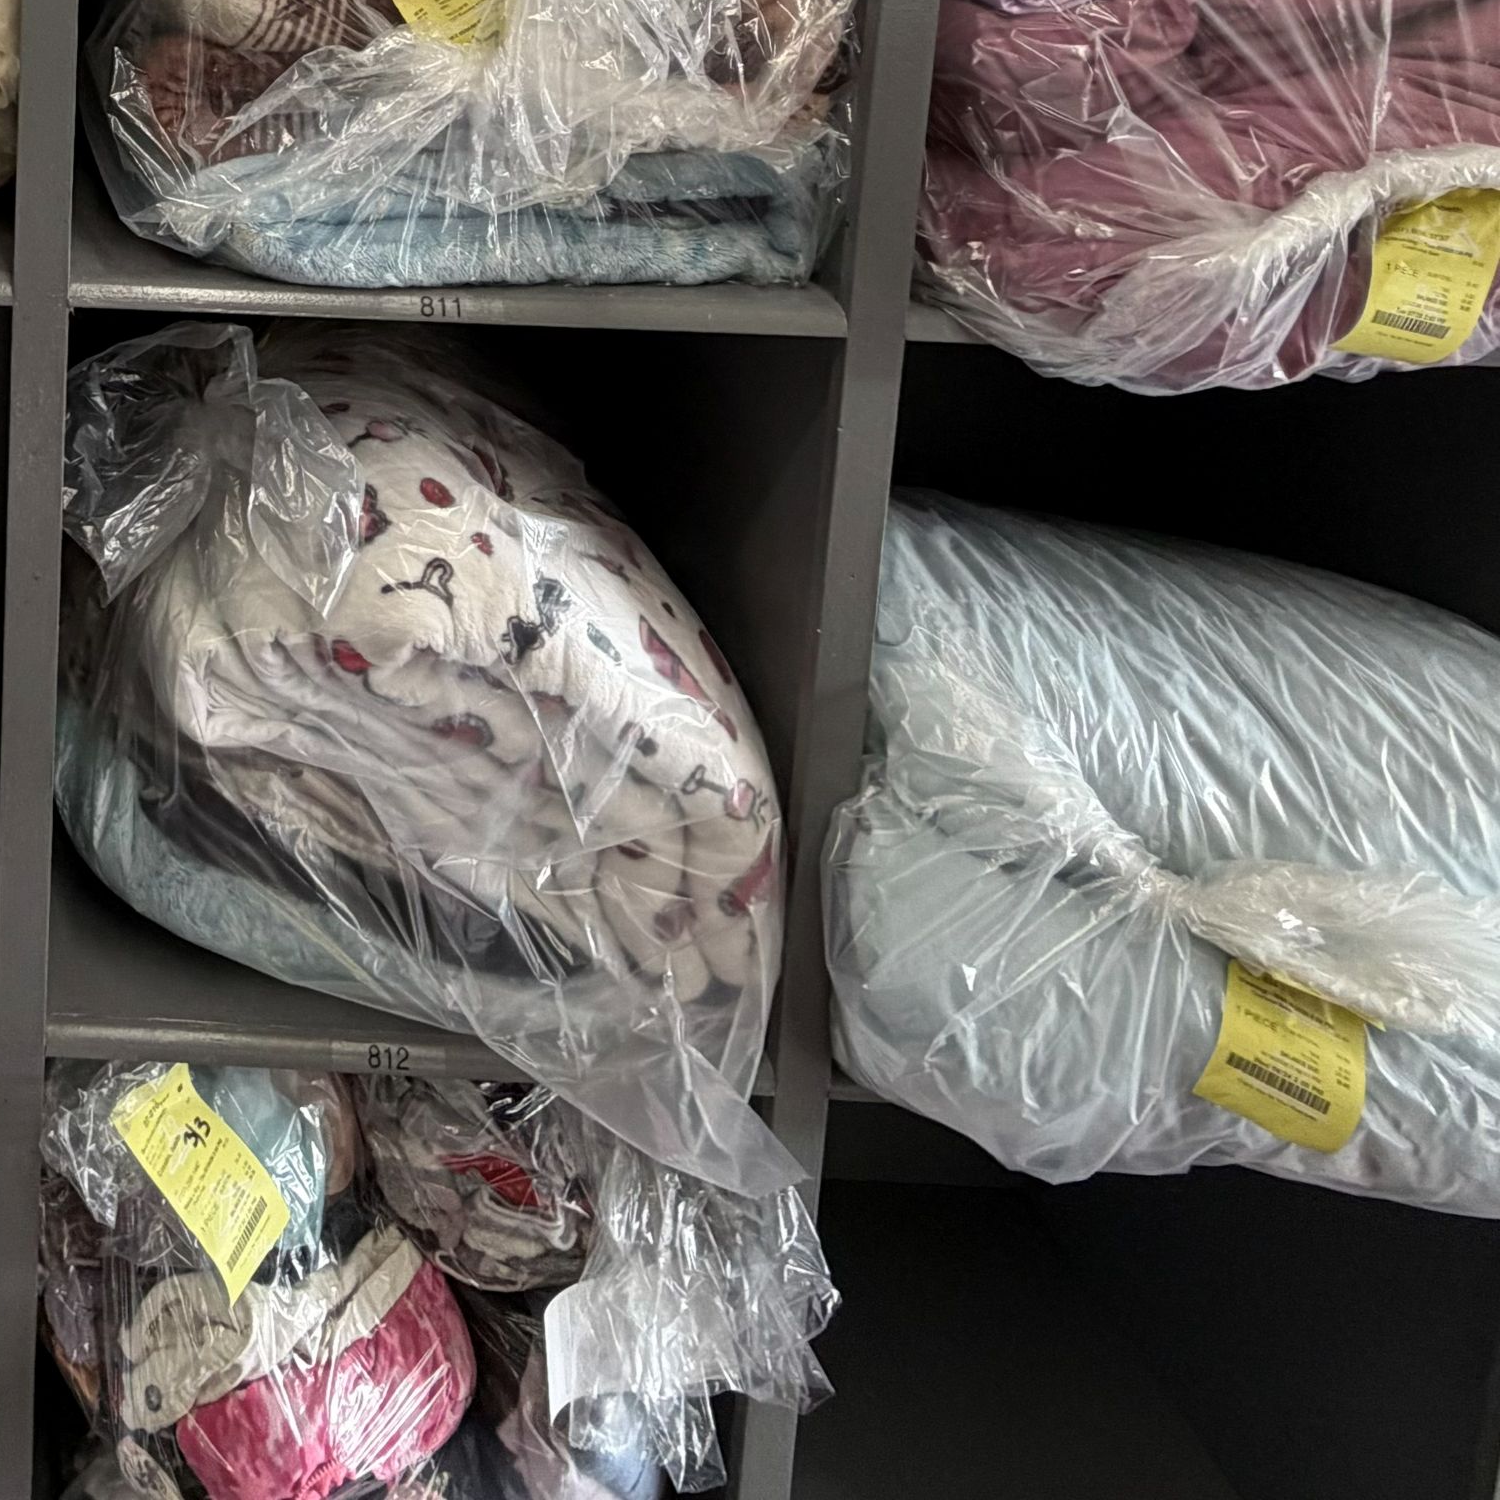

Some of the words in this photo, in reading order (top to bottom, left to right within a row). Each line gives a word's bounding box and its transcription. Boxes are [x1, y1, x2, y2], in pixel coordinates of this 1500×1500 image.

[420, 296, 461, 318] 811
[367, 1044, 409, 1070] 812
[183, 1116, 211, 1148] 3/3
